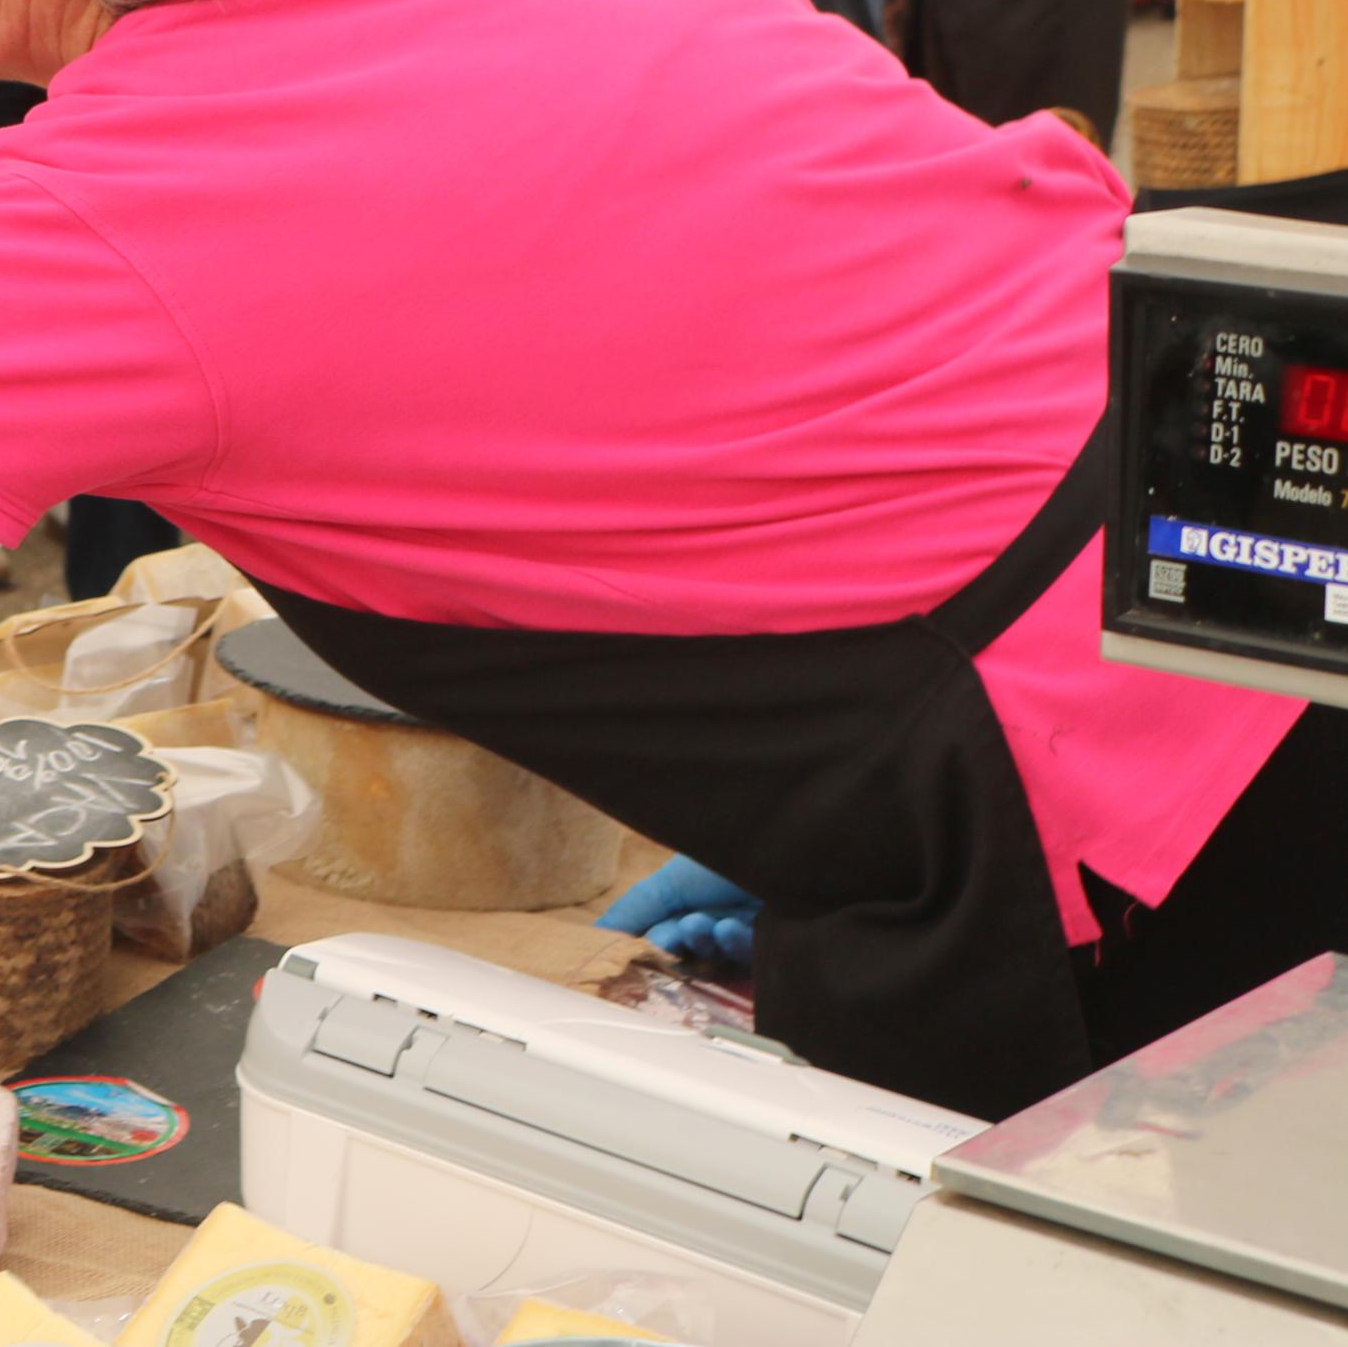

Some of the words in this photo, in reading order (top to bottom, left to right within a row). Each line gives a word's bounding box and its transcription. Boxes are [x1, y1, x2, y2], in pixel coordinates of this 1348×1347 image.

[1215, 332, 1265, 358] CERO
[1214, 377, 1266, 405] TARA
[1212, 399, 1245, 423] F.T.
[1210, 422, 1240, 445] D-1
[1209, 444, 1242, 468] D-2
[1274, 440, 1340, 475] PESO
[1273, 478, 1333, 507] Modelo
